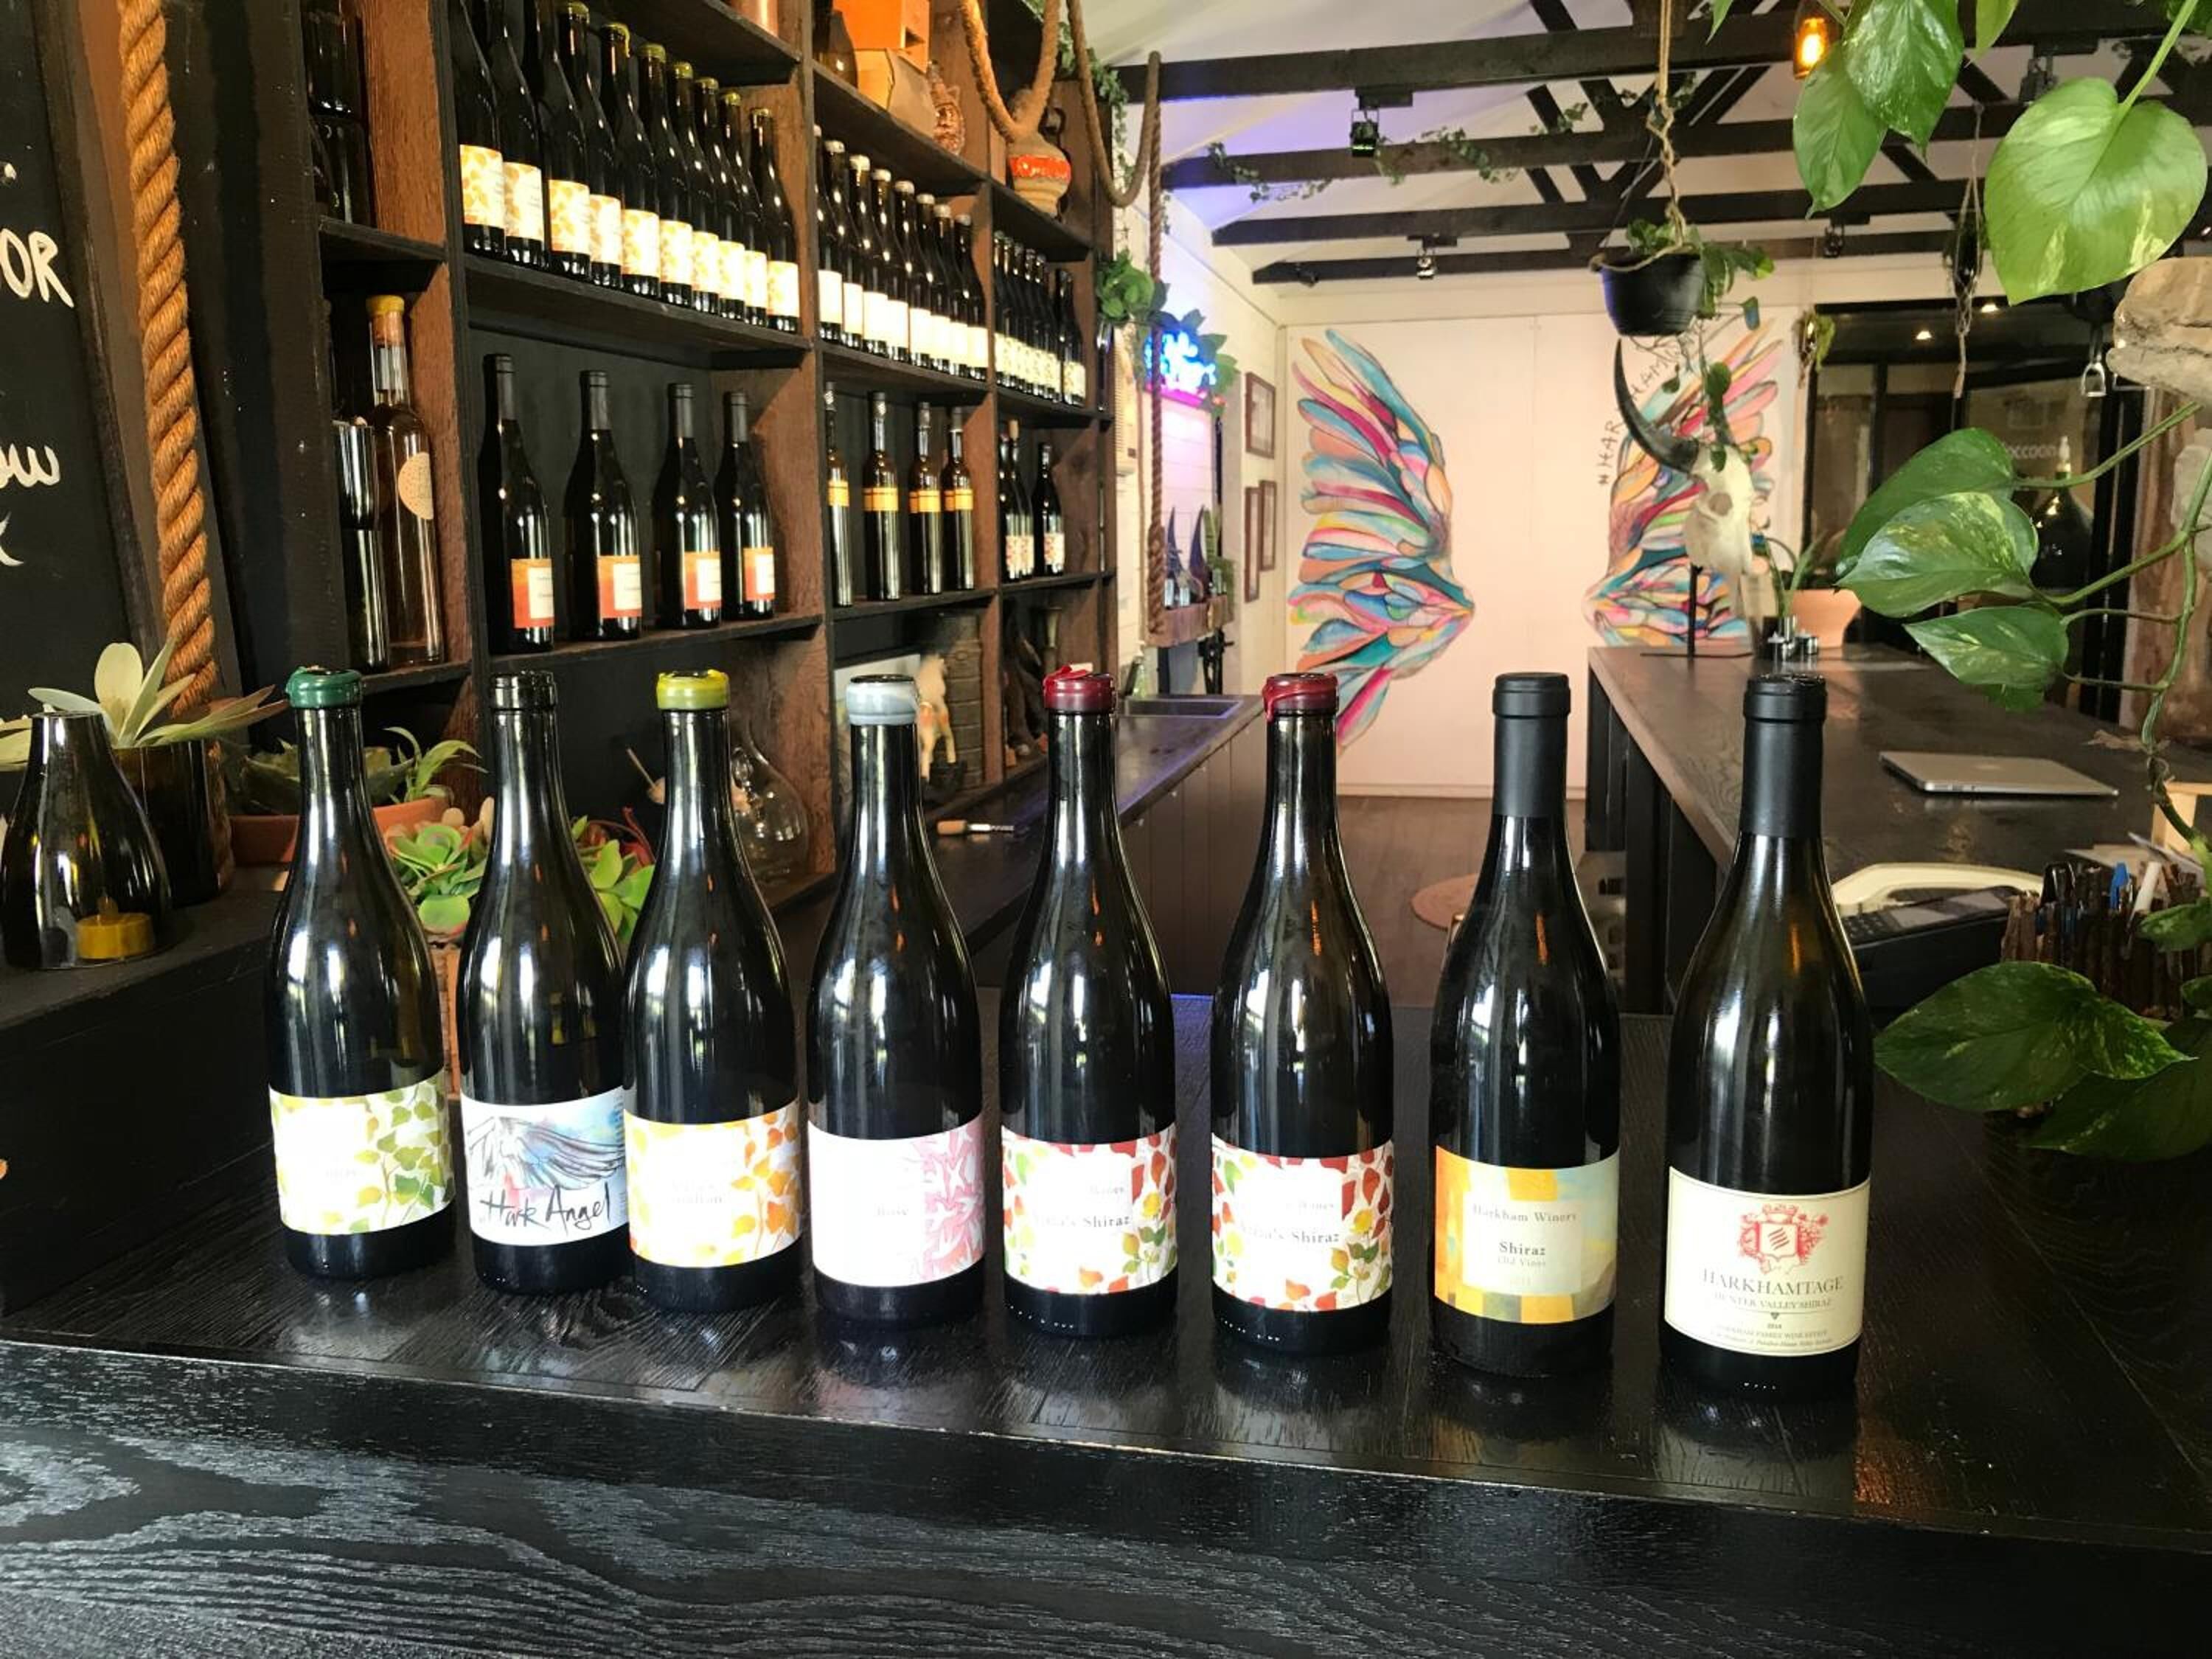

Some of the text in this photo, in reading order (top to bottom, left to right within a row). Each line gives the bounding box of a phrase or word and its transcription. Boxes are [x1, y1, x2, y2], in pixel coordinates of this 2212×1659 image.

[479, 1180, 611, 1237] Hark Angel
[1082, 1215, 1130, 1228] Shiraz
[1291, 1228, 1340, 1244] Shiraz
[1498, 1240, 1546, 1256] Shiraz
[1702, 1267, 1843, 1295] HARKHAMTAGE
